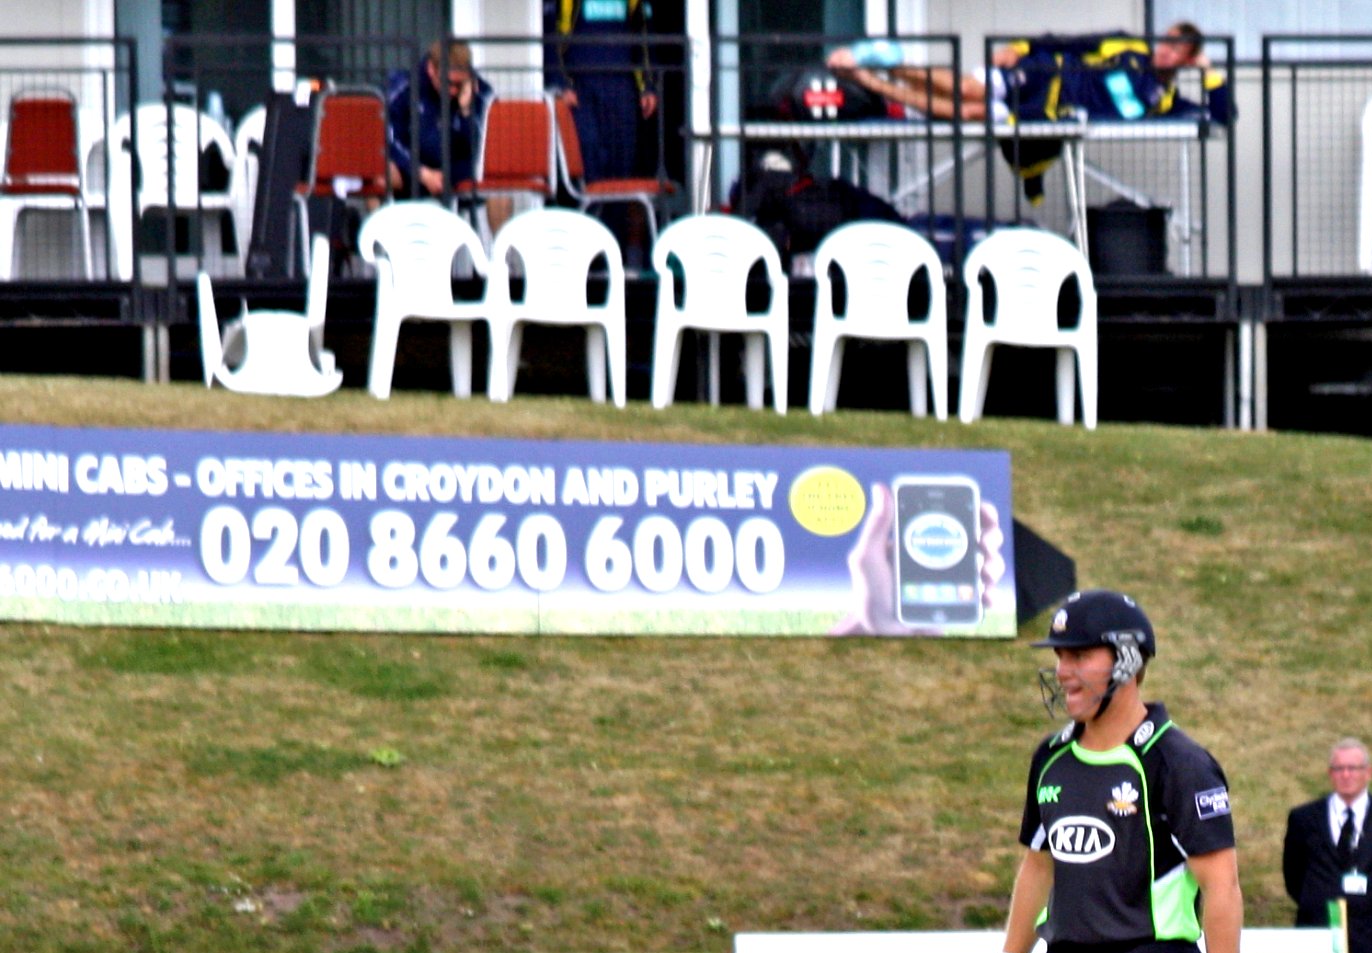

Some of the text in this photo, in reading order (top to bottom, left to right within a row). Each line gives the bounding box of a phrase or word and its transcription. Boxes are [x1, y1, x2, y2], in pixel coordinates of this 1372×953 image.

[0, 451, 69, 494] MINI
[75, 454, 168, 496] CABS
[197, 457, 334, 499] OFFICES
[340, 461, 377, 501] IN
[383, 462, 555, 505] CROYDON
[562, 466, 639, 506] AND
[644, 466, 778, 509] PURLEY
[200, 504, 786, 595] 020 8660 6000
[1055, 826, 1102, 852] KIA
